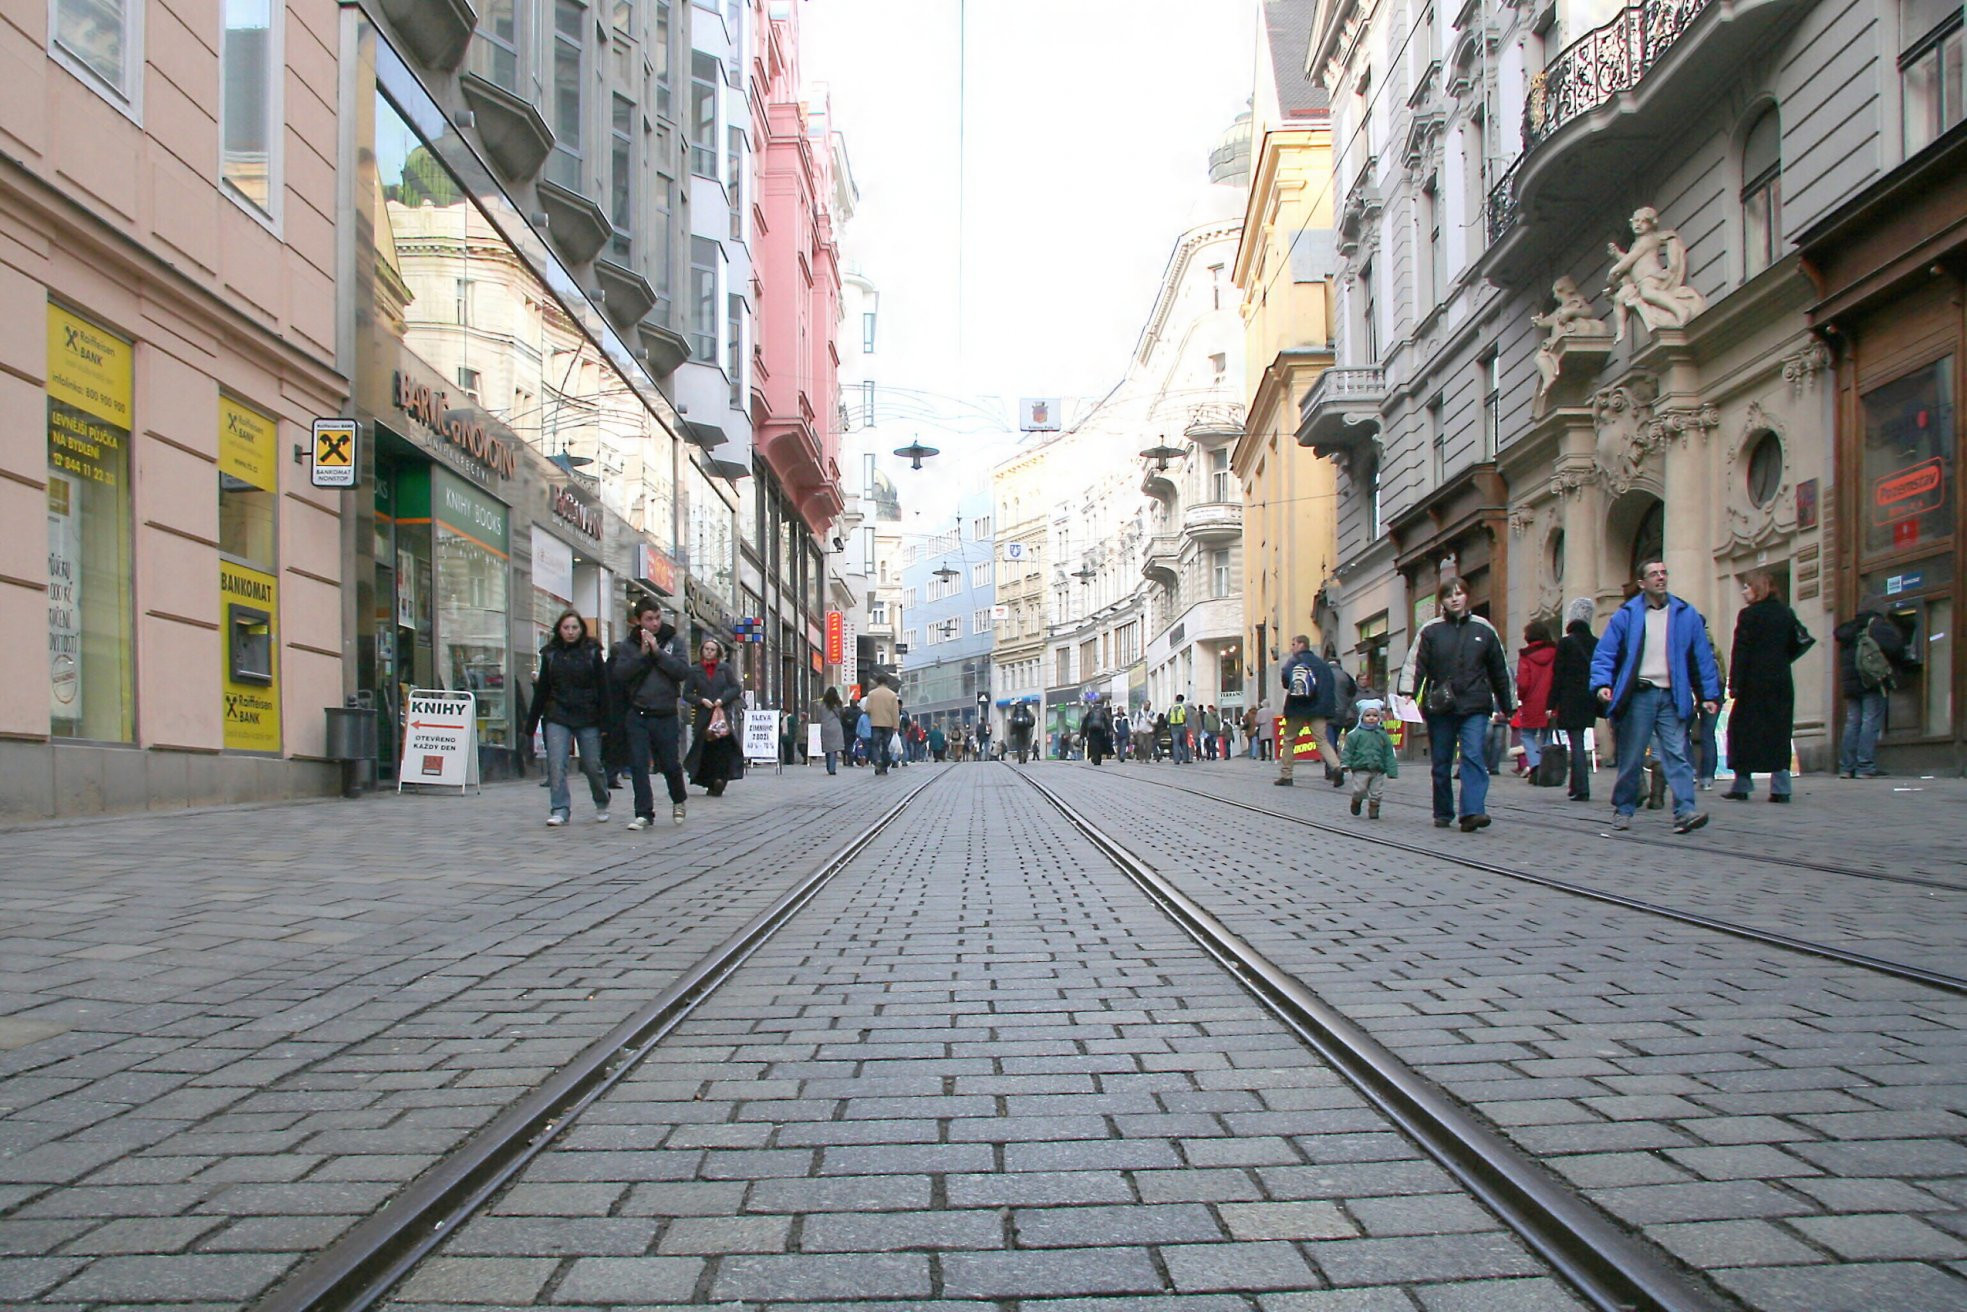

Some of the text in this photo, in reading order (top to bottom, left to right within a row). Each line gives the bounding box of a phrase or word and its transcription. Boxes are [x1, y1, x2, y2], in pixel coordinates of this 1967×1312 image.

[80, 331, 115, 357] Raiffeisen
[81, 347, 103, 368] BANK
[86, 387, 98, 401] 800
[100, 394, 112, 407] 900
[113, 400, 126, 413] 900
[239, 415, 264, 434] Raiffeisen
[52, 430, 66, 447] NA
[239, 428, 255, 443] BANK
[64, 457, 80, 473] 844
[83, 463, 91, 477] 11
[94, 467, 104, 481] 22
[446, 487, 502, 536] KNIHY BOOKS
[221, 572, 272, 603] BANKOMAT
[239, 694, 273, 711] Raiffeisen
[411, 701, 467, 716] KNIHY
[239, 710, 260, 725] BANK
[415, 735, 456, 743] OTEVŘENO
